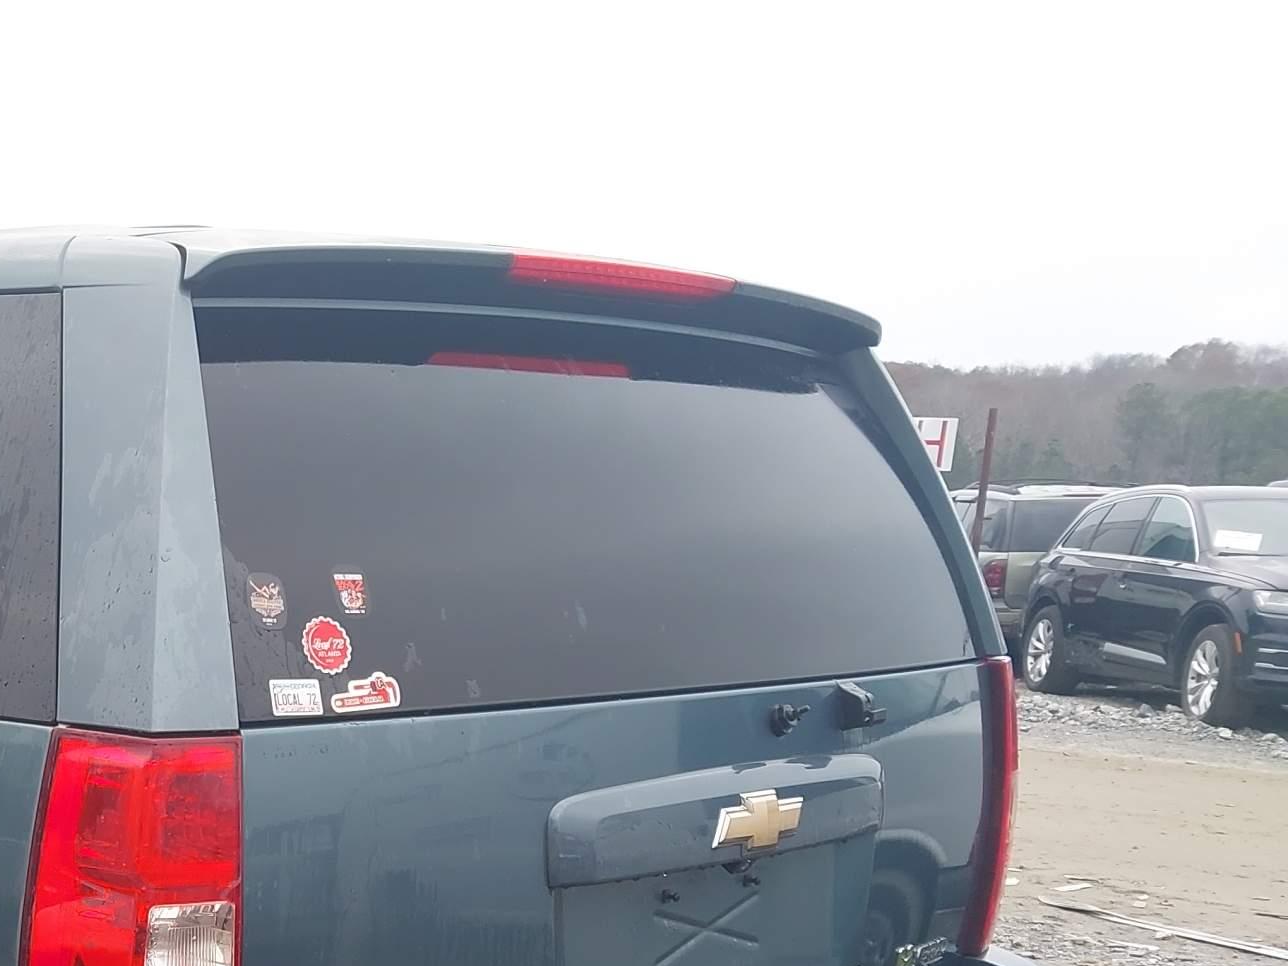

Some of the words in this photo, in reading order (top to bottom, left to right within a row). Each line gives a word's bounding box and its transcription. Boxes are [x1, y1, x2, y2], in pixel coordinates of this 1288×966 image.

[332, 638, 345, 650] 72
[276, 692, 304, 706] LOCAL
[306, 692, 318, 706] 72
